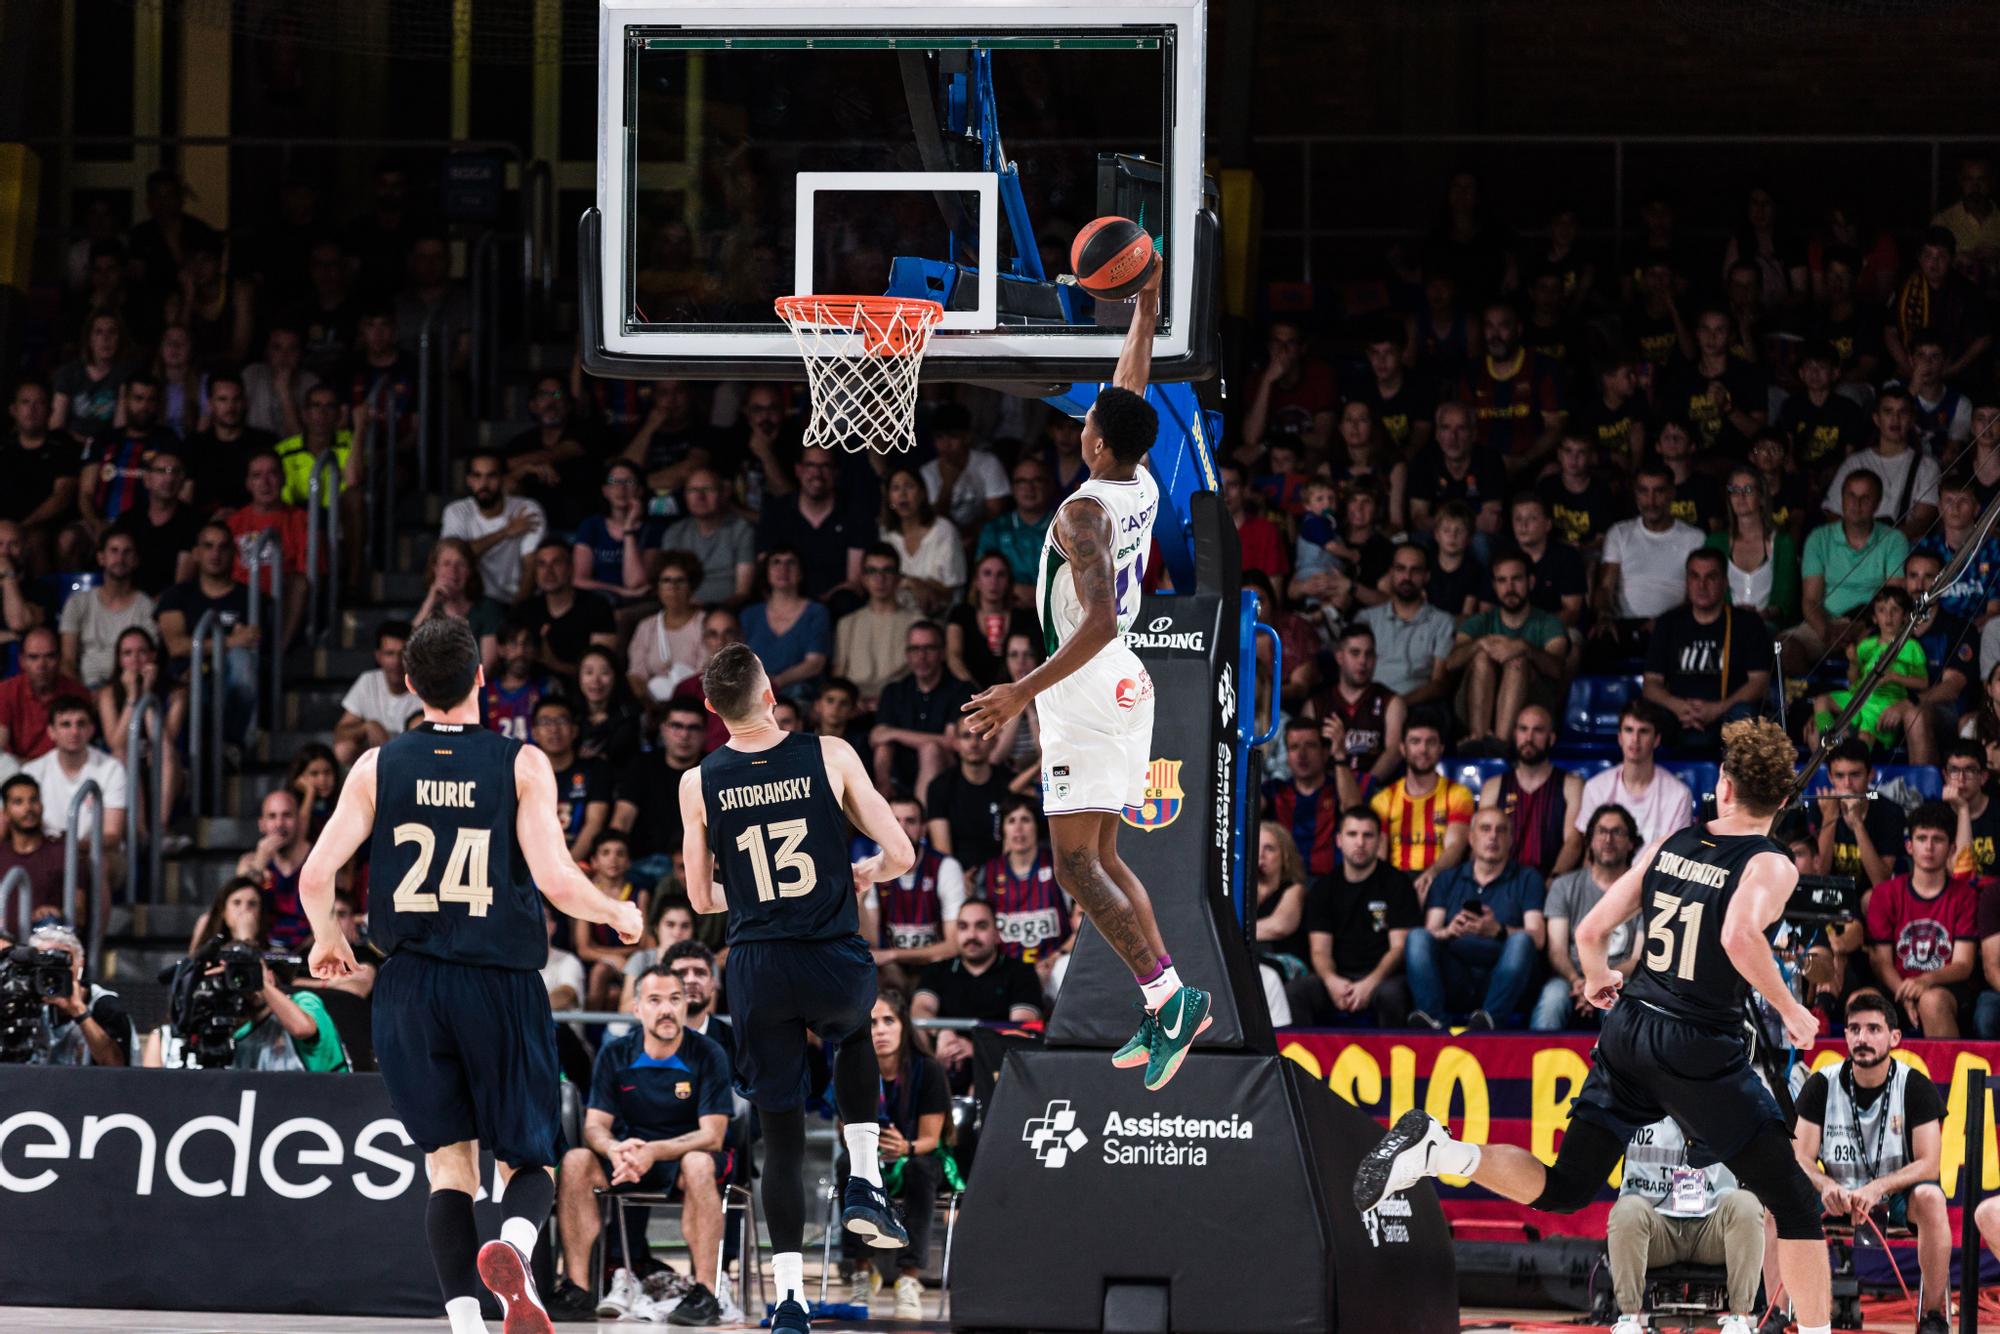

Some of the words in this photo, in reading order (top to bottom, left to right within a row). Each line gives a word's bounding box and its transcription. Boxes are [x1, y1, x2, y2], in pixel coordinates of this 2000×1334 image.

[416, 780, 477, 810] KURIC
[718, 776, 812, 812] SATORANSKY
[1145, 788, 1162, 798] CB
[393, 822, 494, 917] 24
[736, 817, 818, 903] 13
[1646, 891, 1705, 981] 31
[0, 1090, 505, 1202] endes
[1102, 1138, 1208, 1166] Sanitària
[1834, 1144, 1857, 1162] 030
